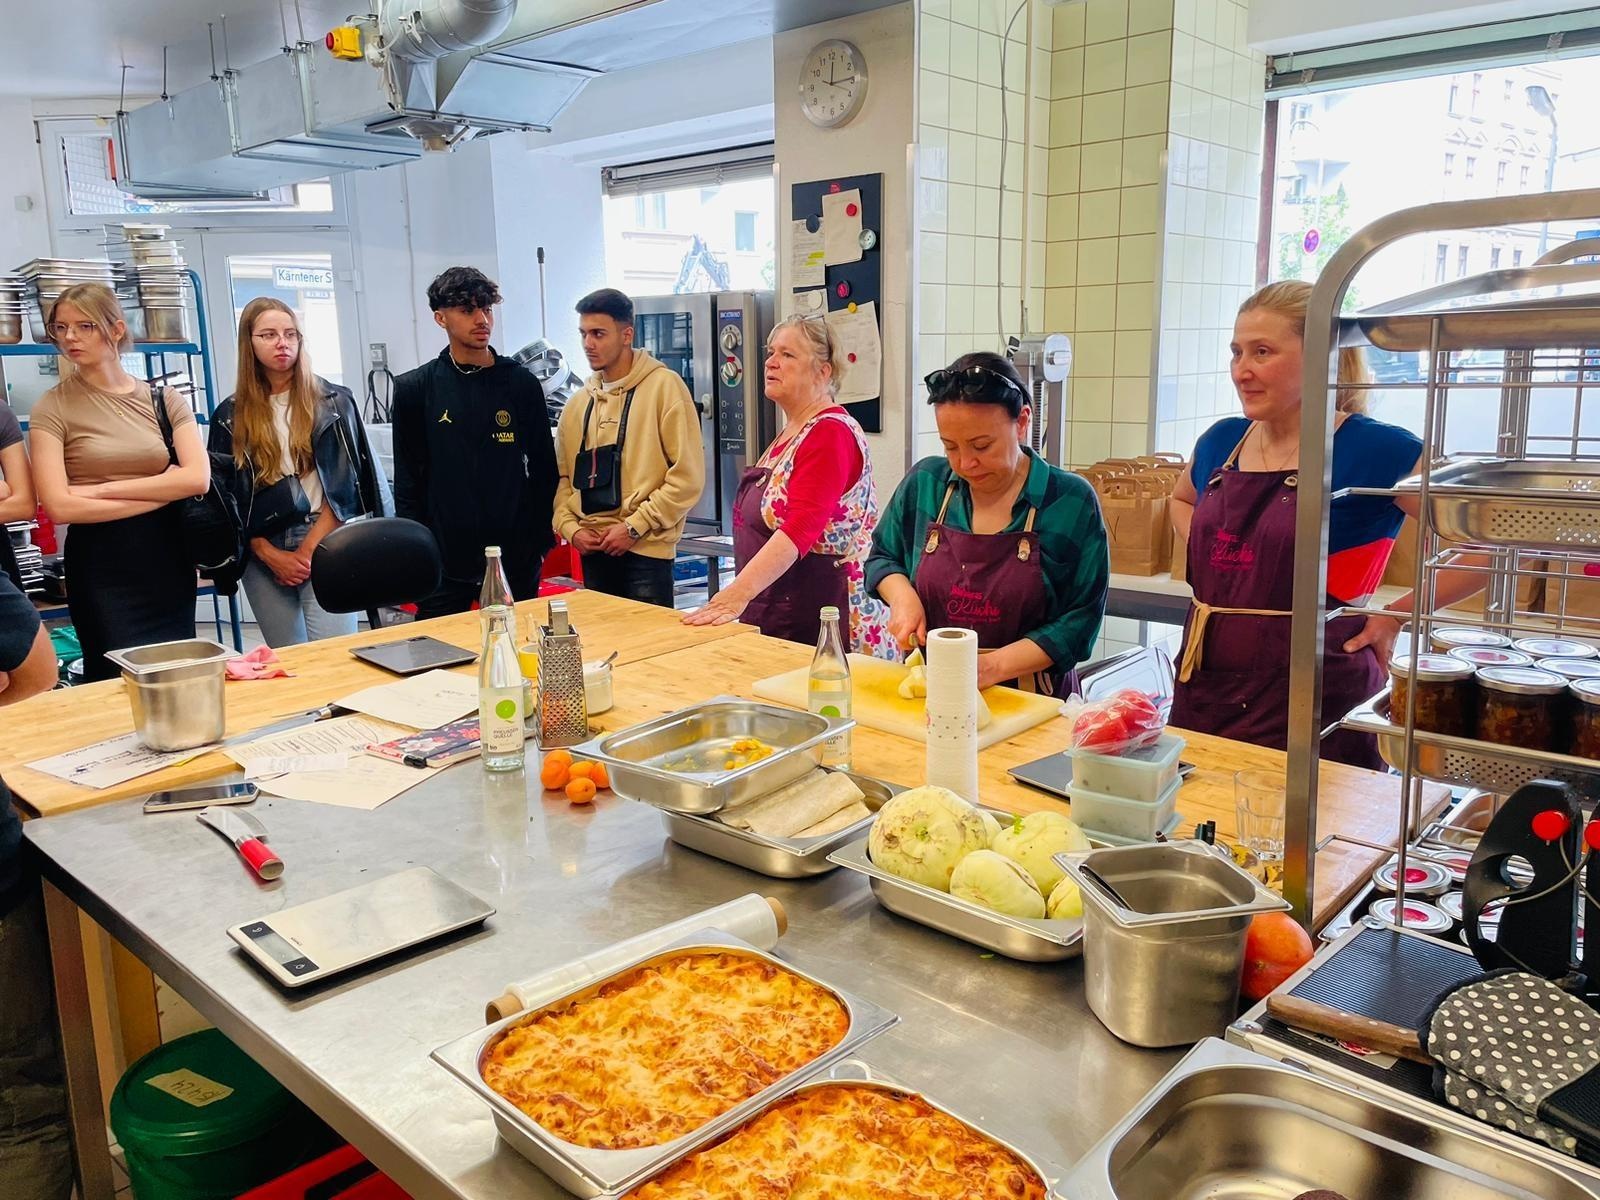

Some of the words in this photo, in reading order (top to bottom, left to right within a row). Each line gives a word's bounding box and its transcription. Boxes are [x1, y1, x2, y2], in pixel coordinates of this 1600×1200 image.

[828, 51, 836, 60] 12
[819, 57, 826, 67] 11
[847, 62, 852, 71] 2
[812, 69, 821, 77] 10
[813, 97, 818, 105] 8
[840, 102, 845, 110] 5
[830, 108, 835, 116] 6
[278, 268, 323, 283] Kärntener
